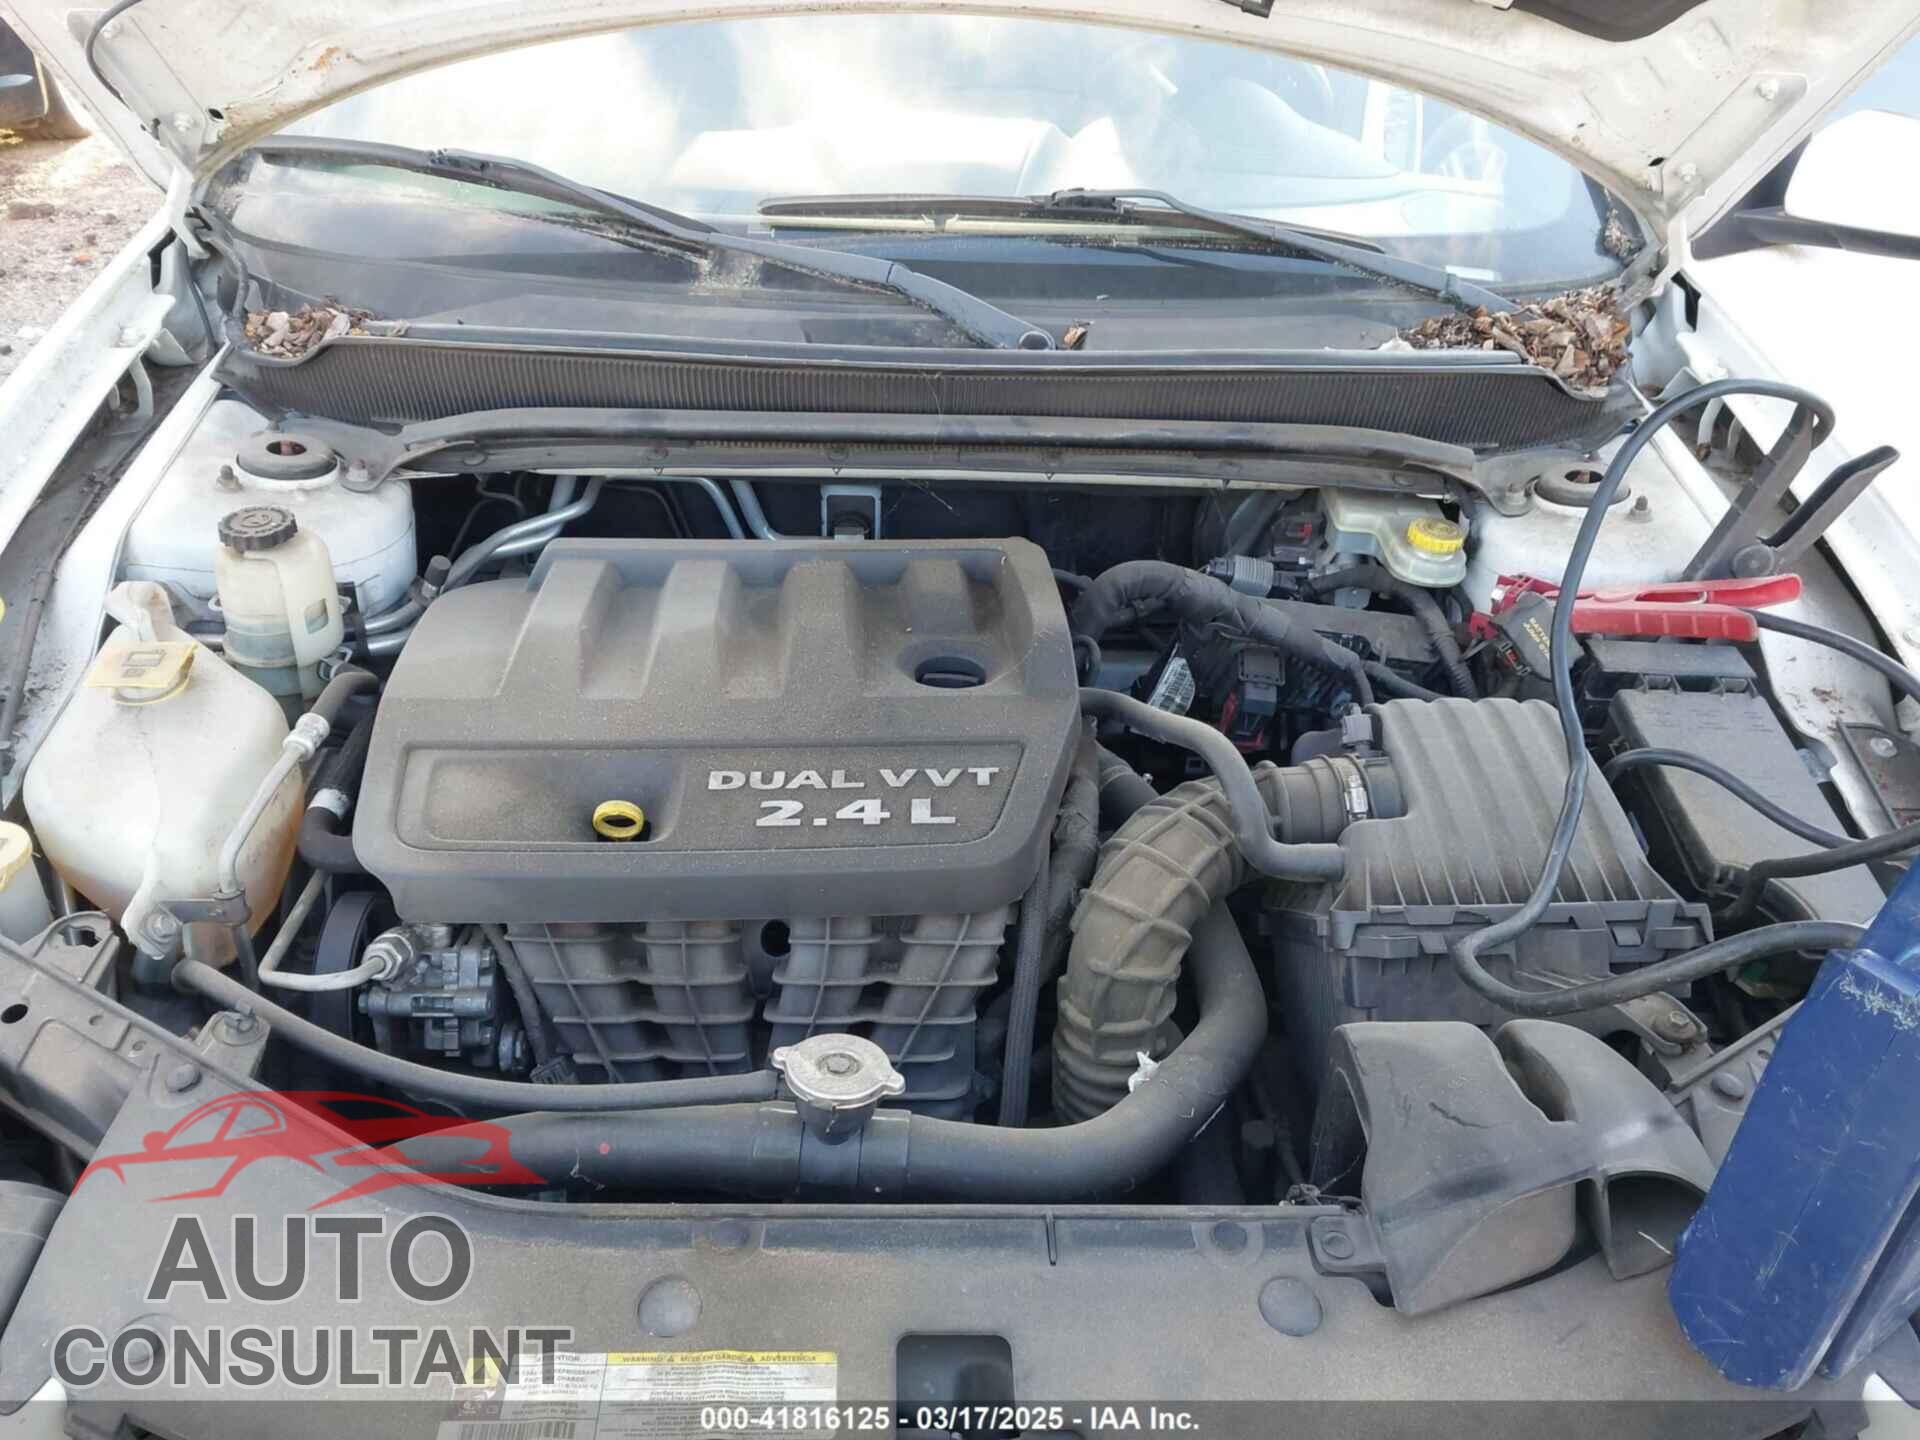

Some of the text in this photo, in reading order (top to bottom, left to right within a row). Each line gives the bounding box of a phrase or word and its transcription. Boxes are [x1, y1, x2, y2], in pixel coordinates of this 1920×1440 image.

[707, 767, 1000, 790] DUAL VVT
[755, 798, 957, 826] 2.4 L
